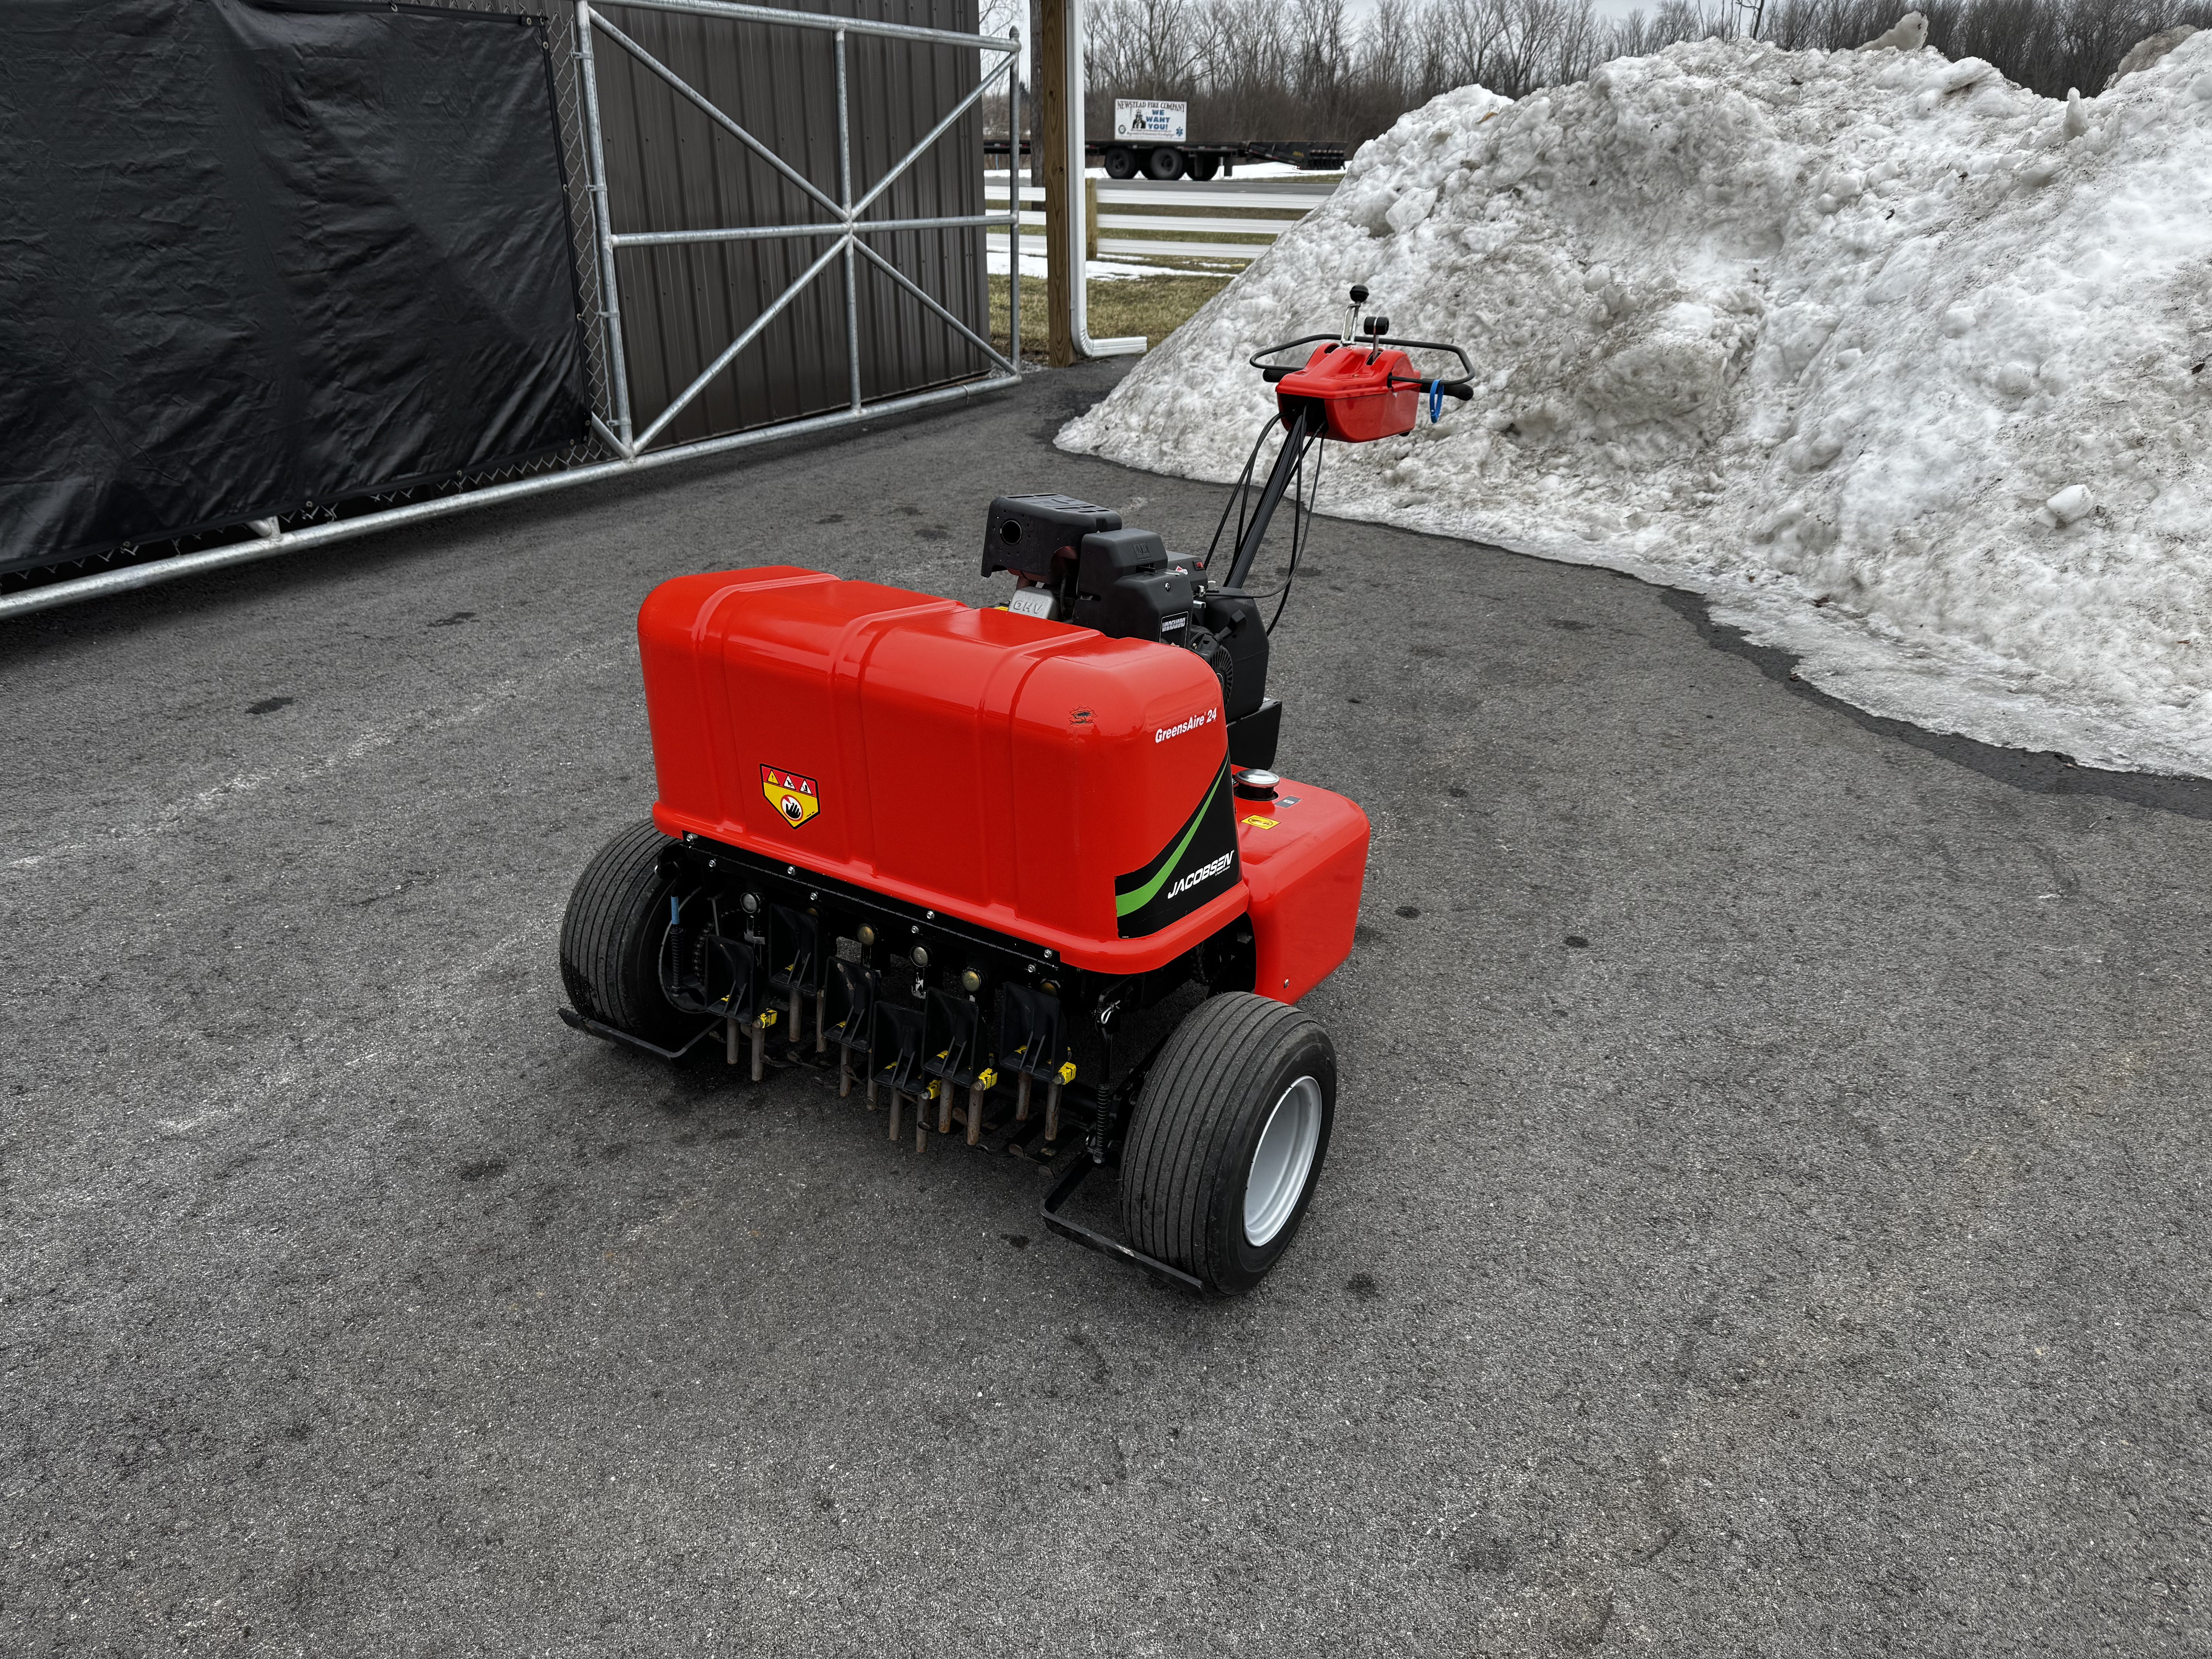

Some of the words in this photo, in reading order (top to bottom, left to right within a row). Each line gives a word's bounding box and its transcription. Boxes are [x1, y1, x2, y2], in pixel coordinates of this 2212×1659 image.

[1118, 101, 1146, 110] NEWSTEAD
[1161, 103, 1184, 112] COMPANY
[1013, 600, 1043, 614] OHV
[1162, 617, 1186, 632] VANGUARD
[1206, 707, 1217, 723] 24
[1168, 850, 1235, 899] JACOBSEN
